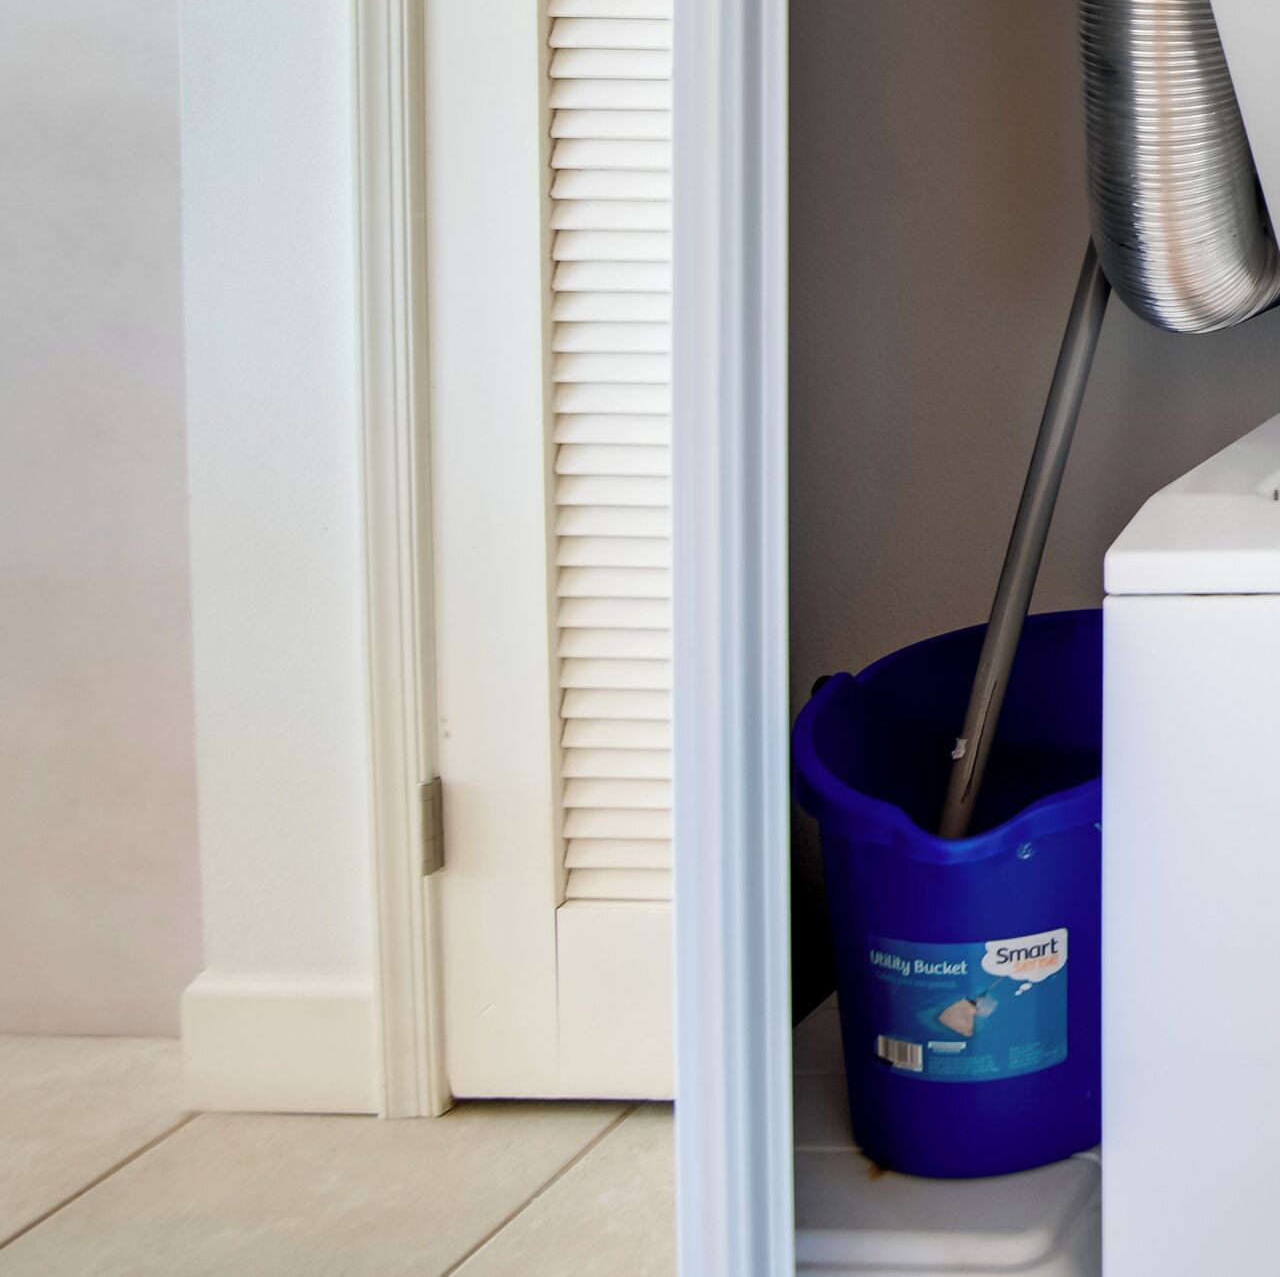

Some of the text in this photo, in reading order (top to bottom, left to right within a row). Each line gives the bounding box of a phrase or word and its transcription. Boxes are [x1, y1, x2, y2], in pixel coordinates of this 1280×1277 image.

[869, 949, 969, 977] Utility Bucket
[995, 937, 1060, 965] Smart
